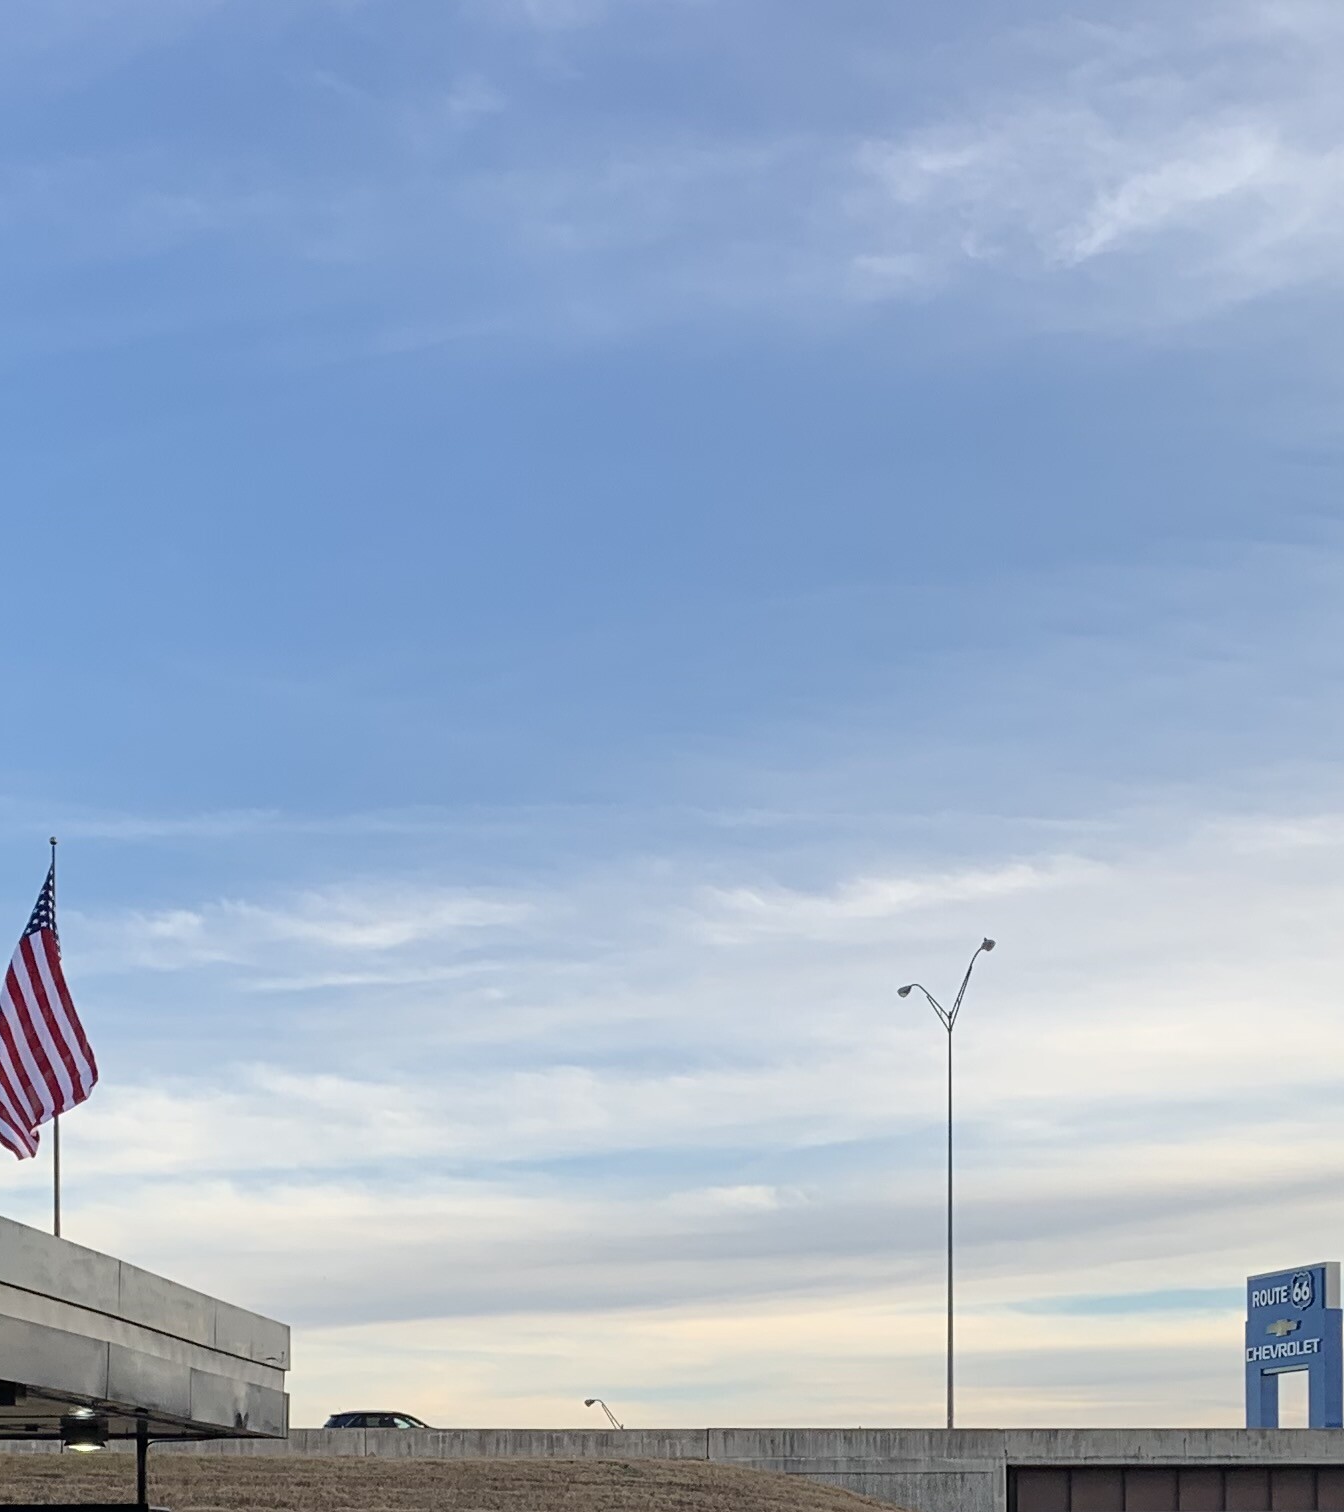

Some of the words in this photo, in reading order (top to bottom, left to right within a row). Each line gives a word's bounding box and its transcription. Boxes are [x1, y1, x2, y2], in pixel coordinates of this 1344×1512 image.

[1252, 1285, 1288, 1308] ROUTE
[1292, 1280, 1310, 1302] 66
[1246, 1338, 1320, 1362] CHEVROLET
